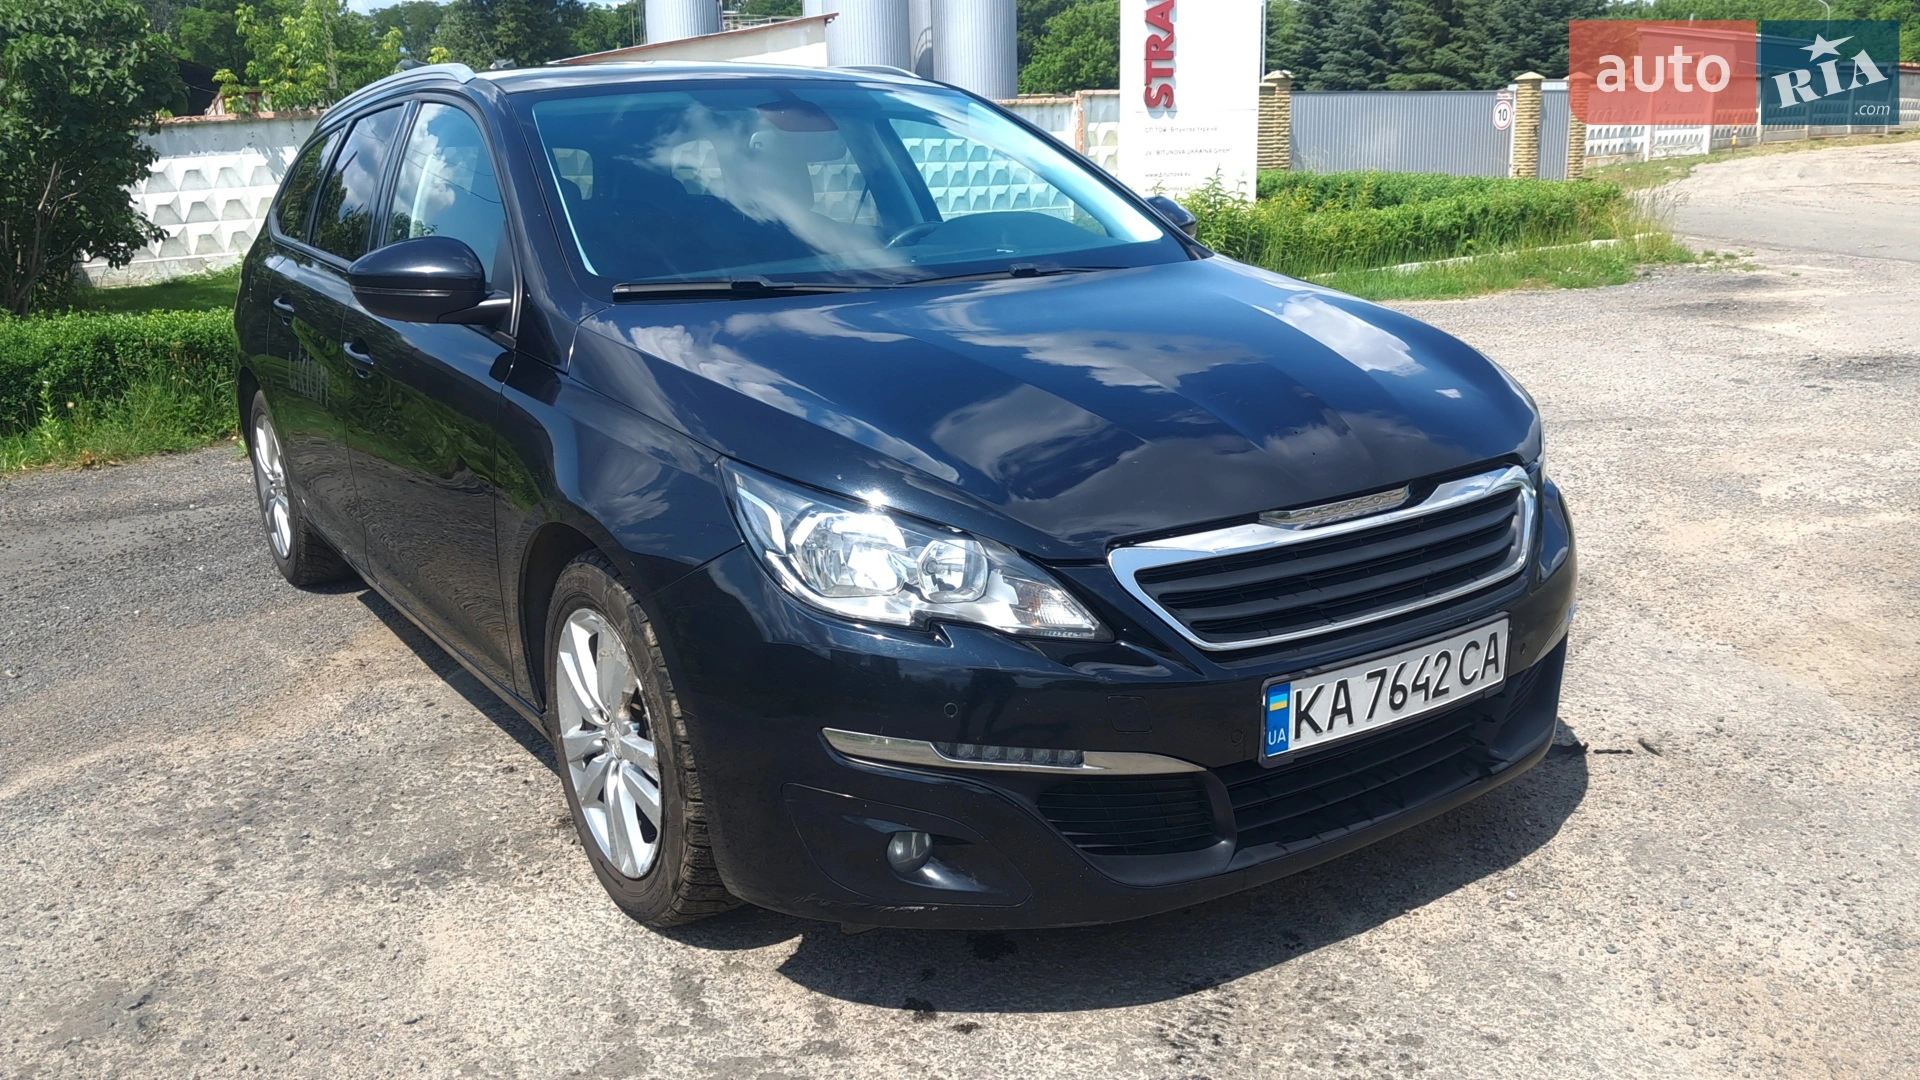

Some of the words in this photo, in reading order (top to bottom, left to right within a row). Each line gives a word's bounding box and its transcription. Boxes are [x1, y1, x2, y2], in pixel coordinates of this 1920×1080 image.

[1144, 0, 1175, 108] STRA
[1497, 108, 1508, 122] 10
[1293, 678, 1354, 740] KA
[1365, 651, 1452, 721] 7642
[1459, 631, 1500, 686] CA
[1267, 728, 1287, 746] UA
